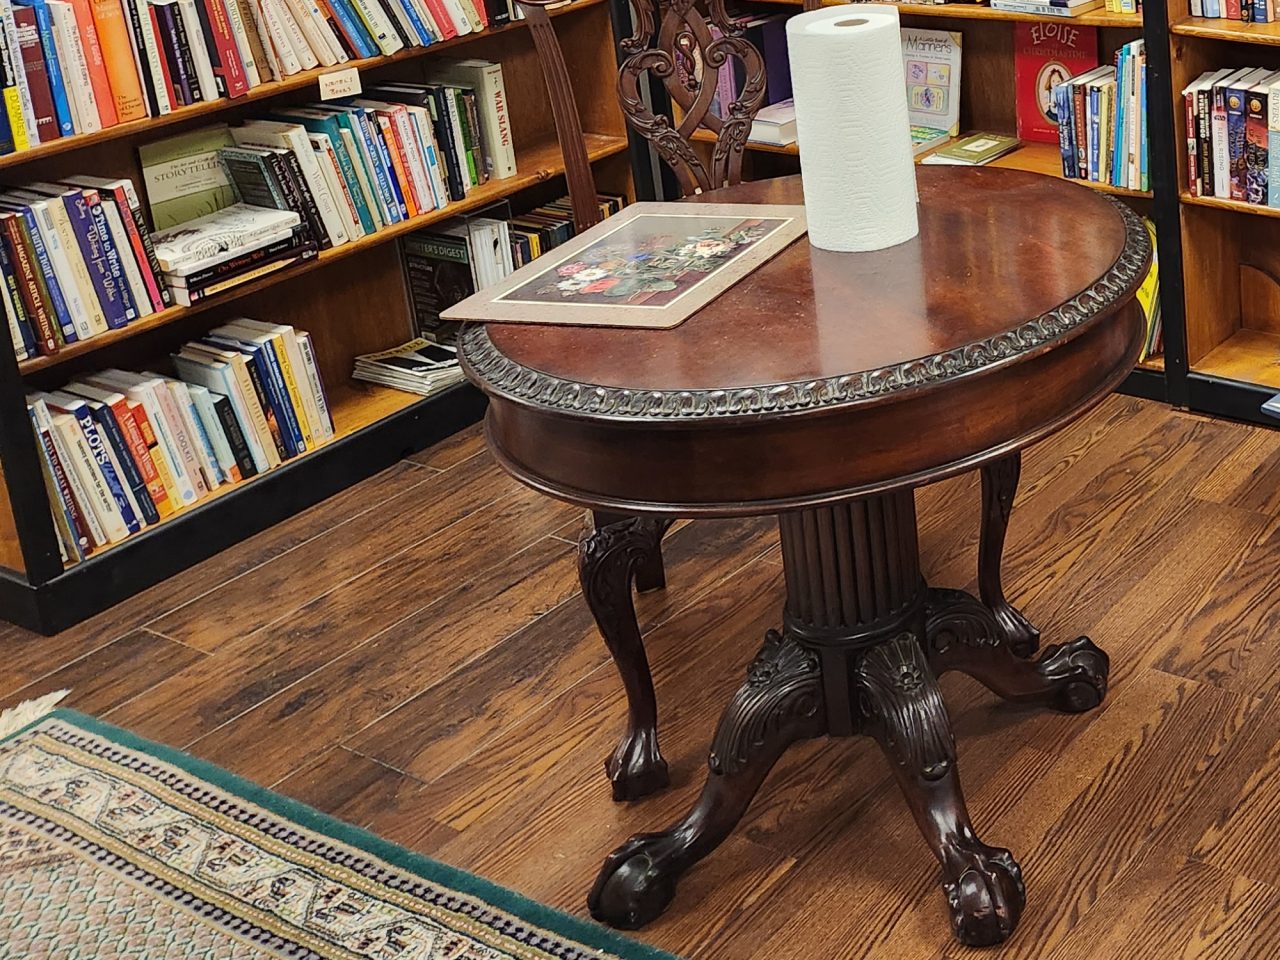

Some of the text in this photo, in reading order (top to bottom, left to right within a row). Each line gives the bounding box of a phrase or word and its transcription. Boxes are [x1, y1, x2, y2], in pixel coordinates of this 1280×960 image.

[906, 34, 952, 55] Manners
[1030, 22, 1079, 48] ELOISE
[493, 90, 510, 147] WAR SLANG
[95, 213, 121, 277] Time to Write
[439, 244, 465, 258] DIGEST
[80, 417, 109, 465] PLOTS
[176, 430, 194, 463] TOOLKIT
